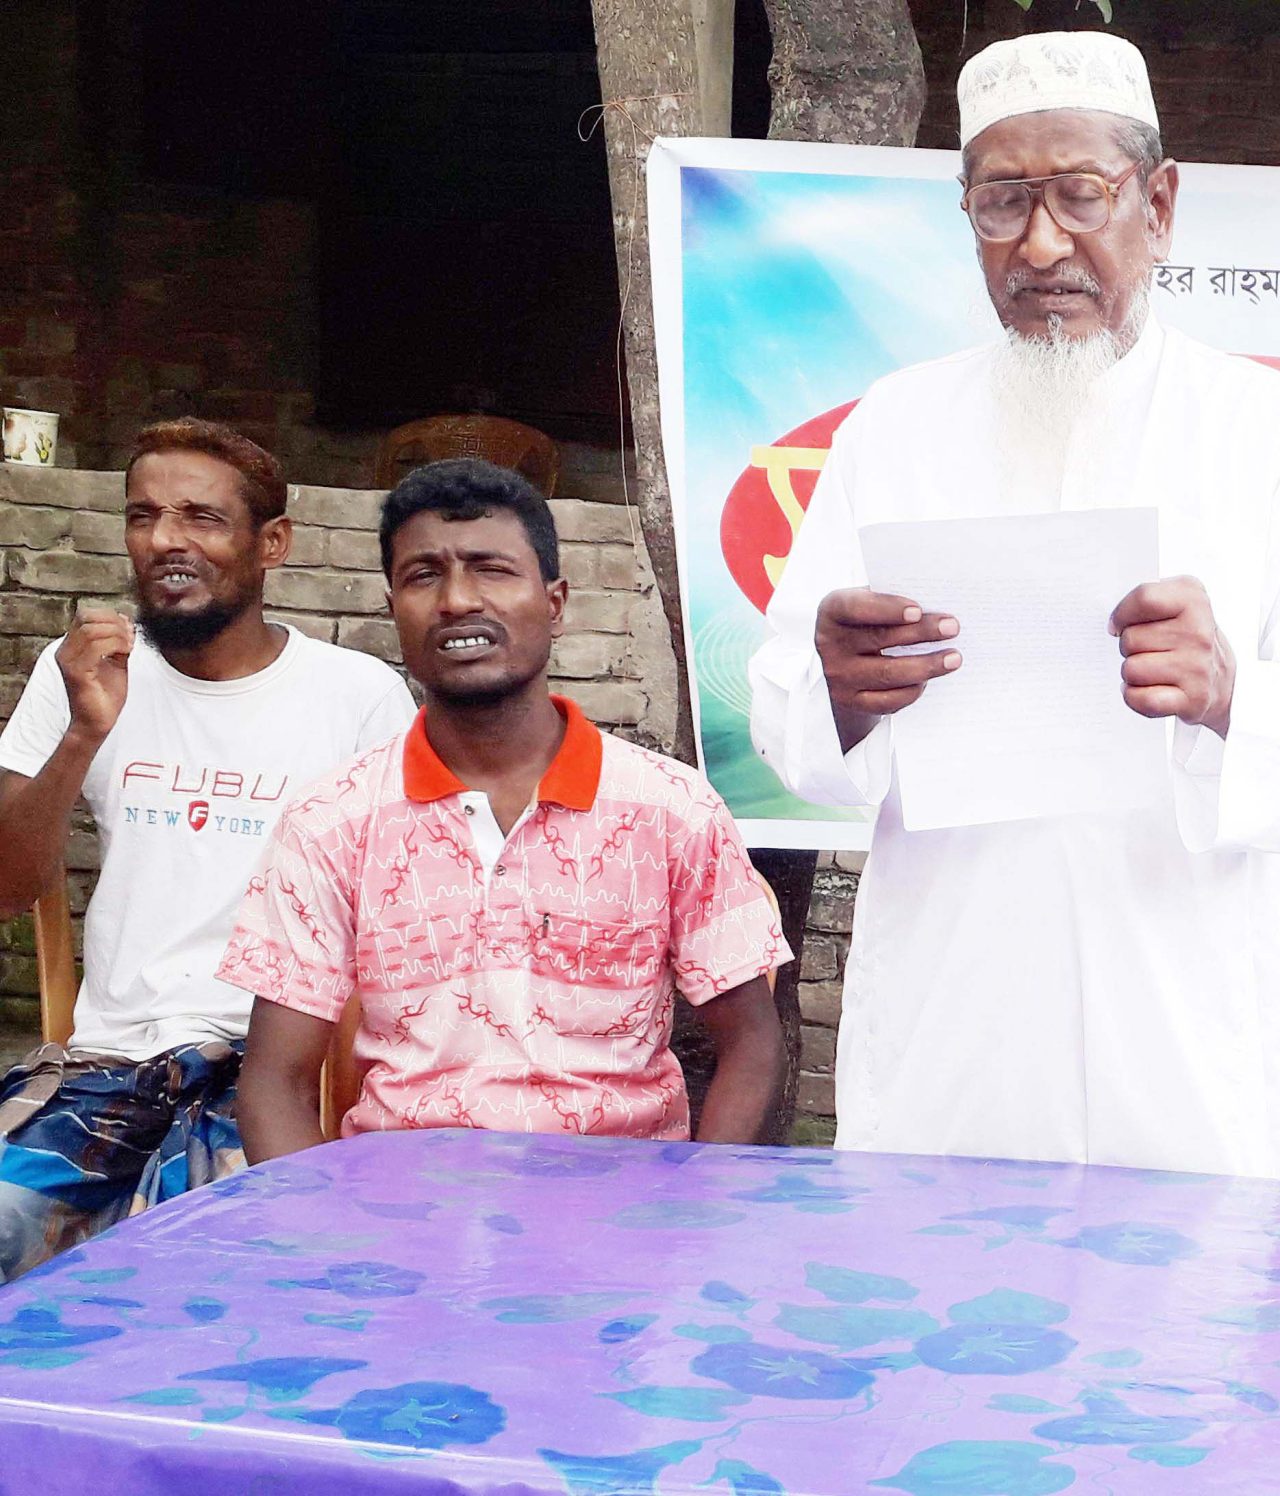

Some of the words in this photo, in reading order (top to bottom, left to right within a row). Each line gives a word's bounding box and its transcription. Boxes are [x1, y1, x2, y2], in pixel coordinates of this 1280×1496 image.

[122, 761, 288, 801] FUBU
[124, 807, 181, 827] NEW
[215, 815, 265, 836] YORK
